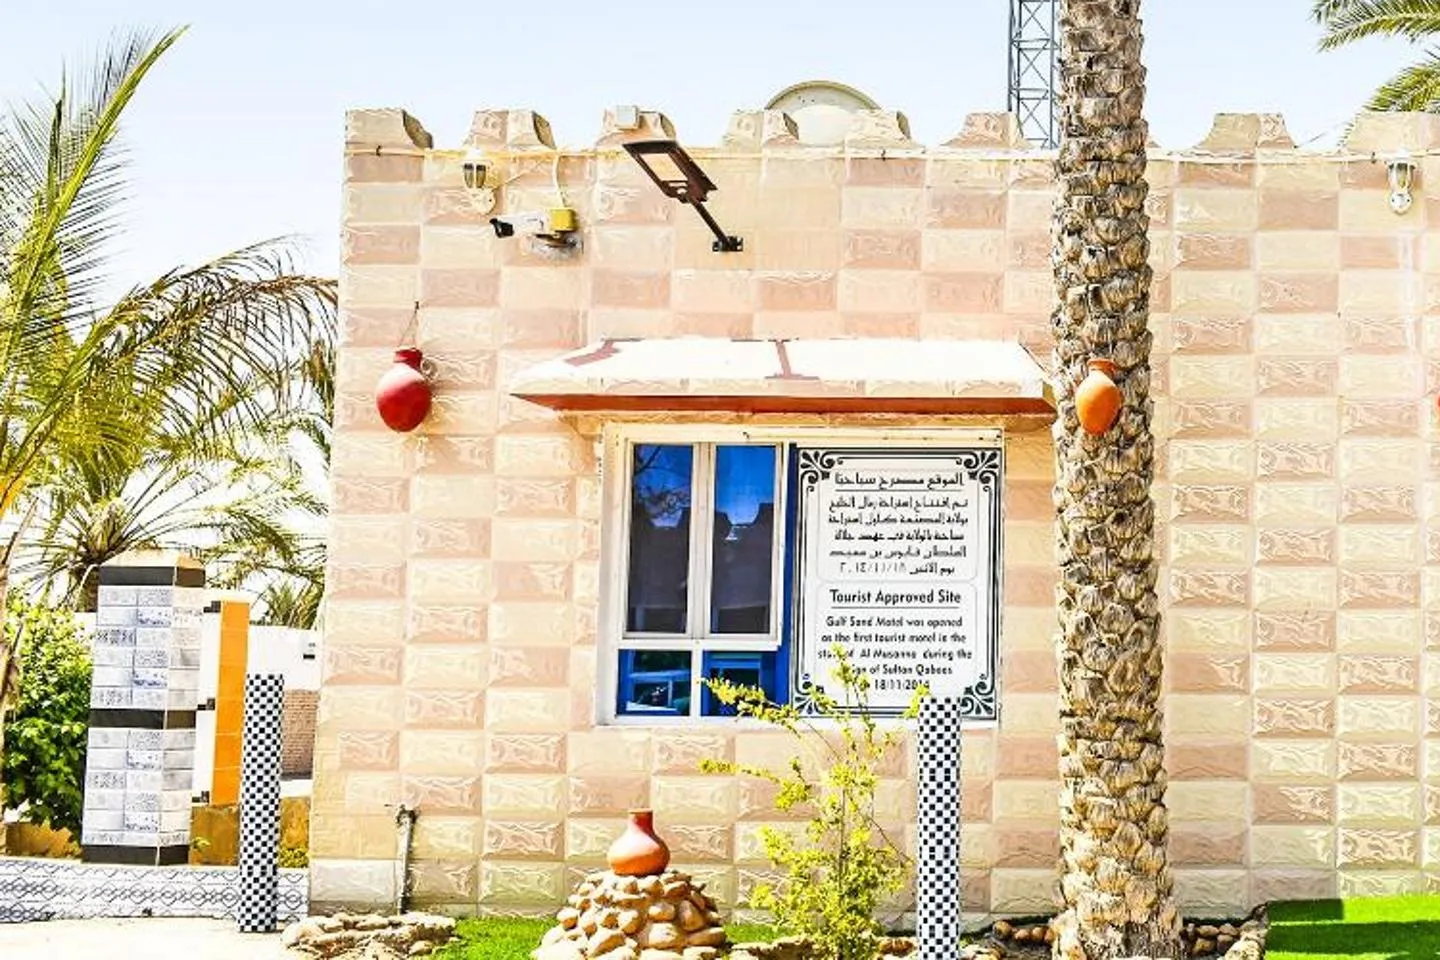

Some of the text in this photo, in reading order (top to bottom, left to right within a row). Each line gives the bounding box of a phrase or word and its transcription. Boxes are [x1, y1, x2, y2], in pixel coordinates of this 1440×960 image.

[879, 476, 924, 491] مصرح
[927, 472, 965, 491] الموقع
[829, 589, 962, 605] Tourist Approved Site
[825, 616, 963, 629] Gulf Sand Motel was opened
[835, 632, 850, 642] the
[875, 632, 906, 642] tourist
[950, 632, 966, 643] the
[860, 648, 871, 658] Al
[957, 648, 973, 659] the
[869, 664, 880, 674] of
[882, 664, 913, 675] Sultan
